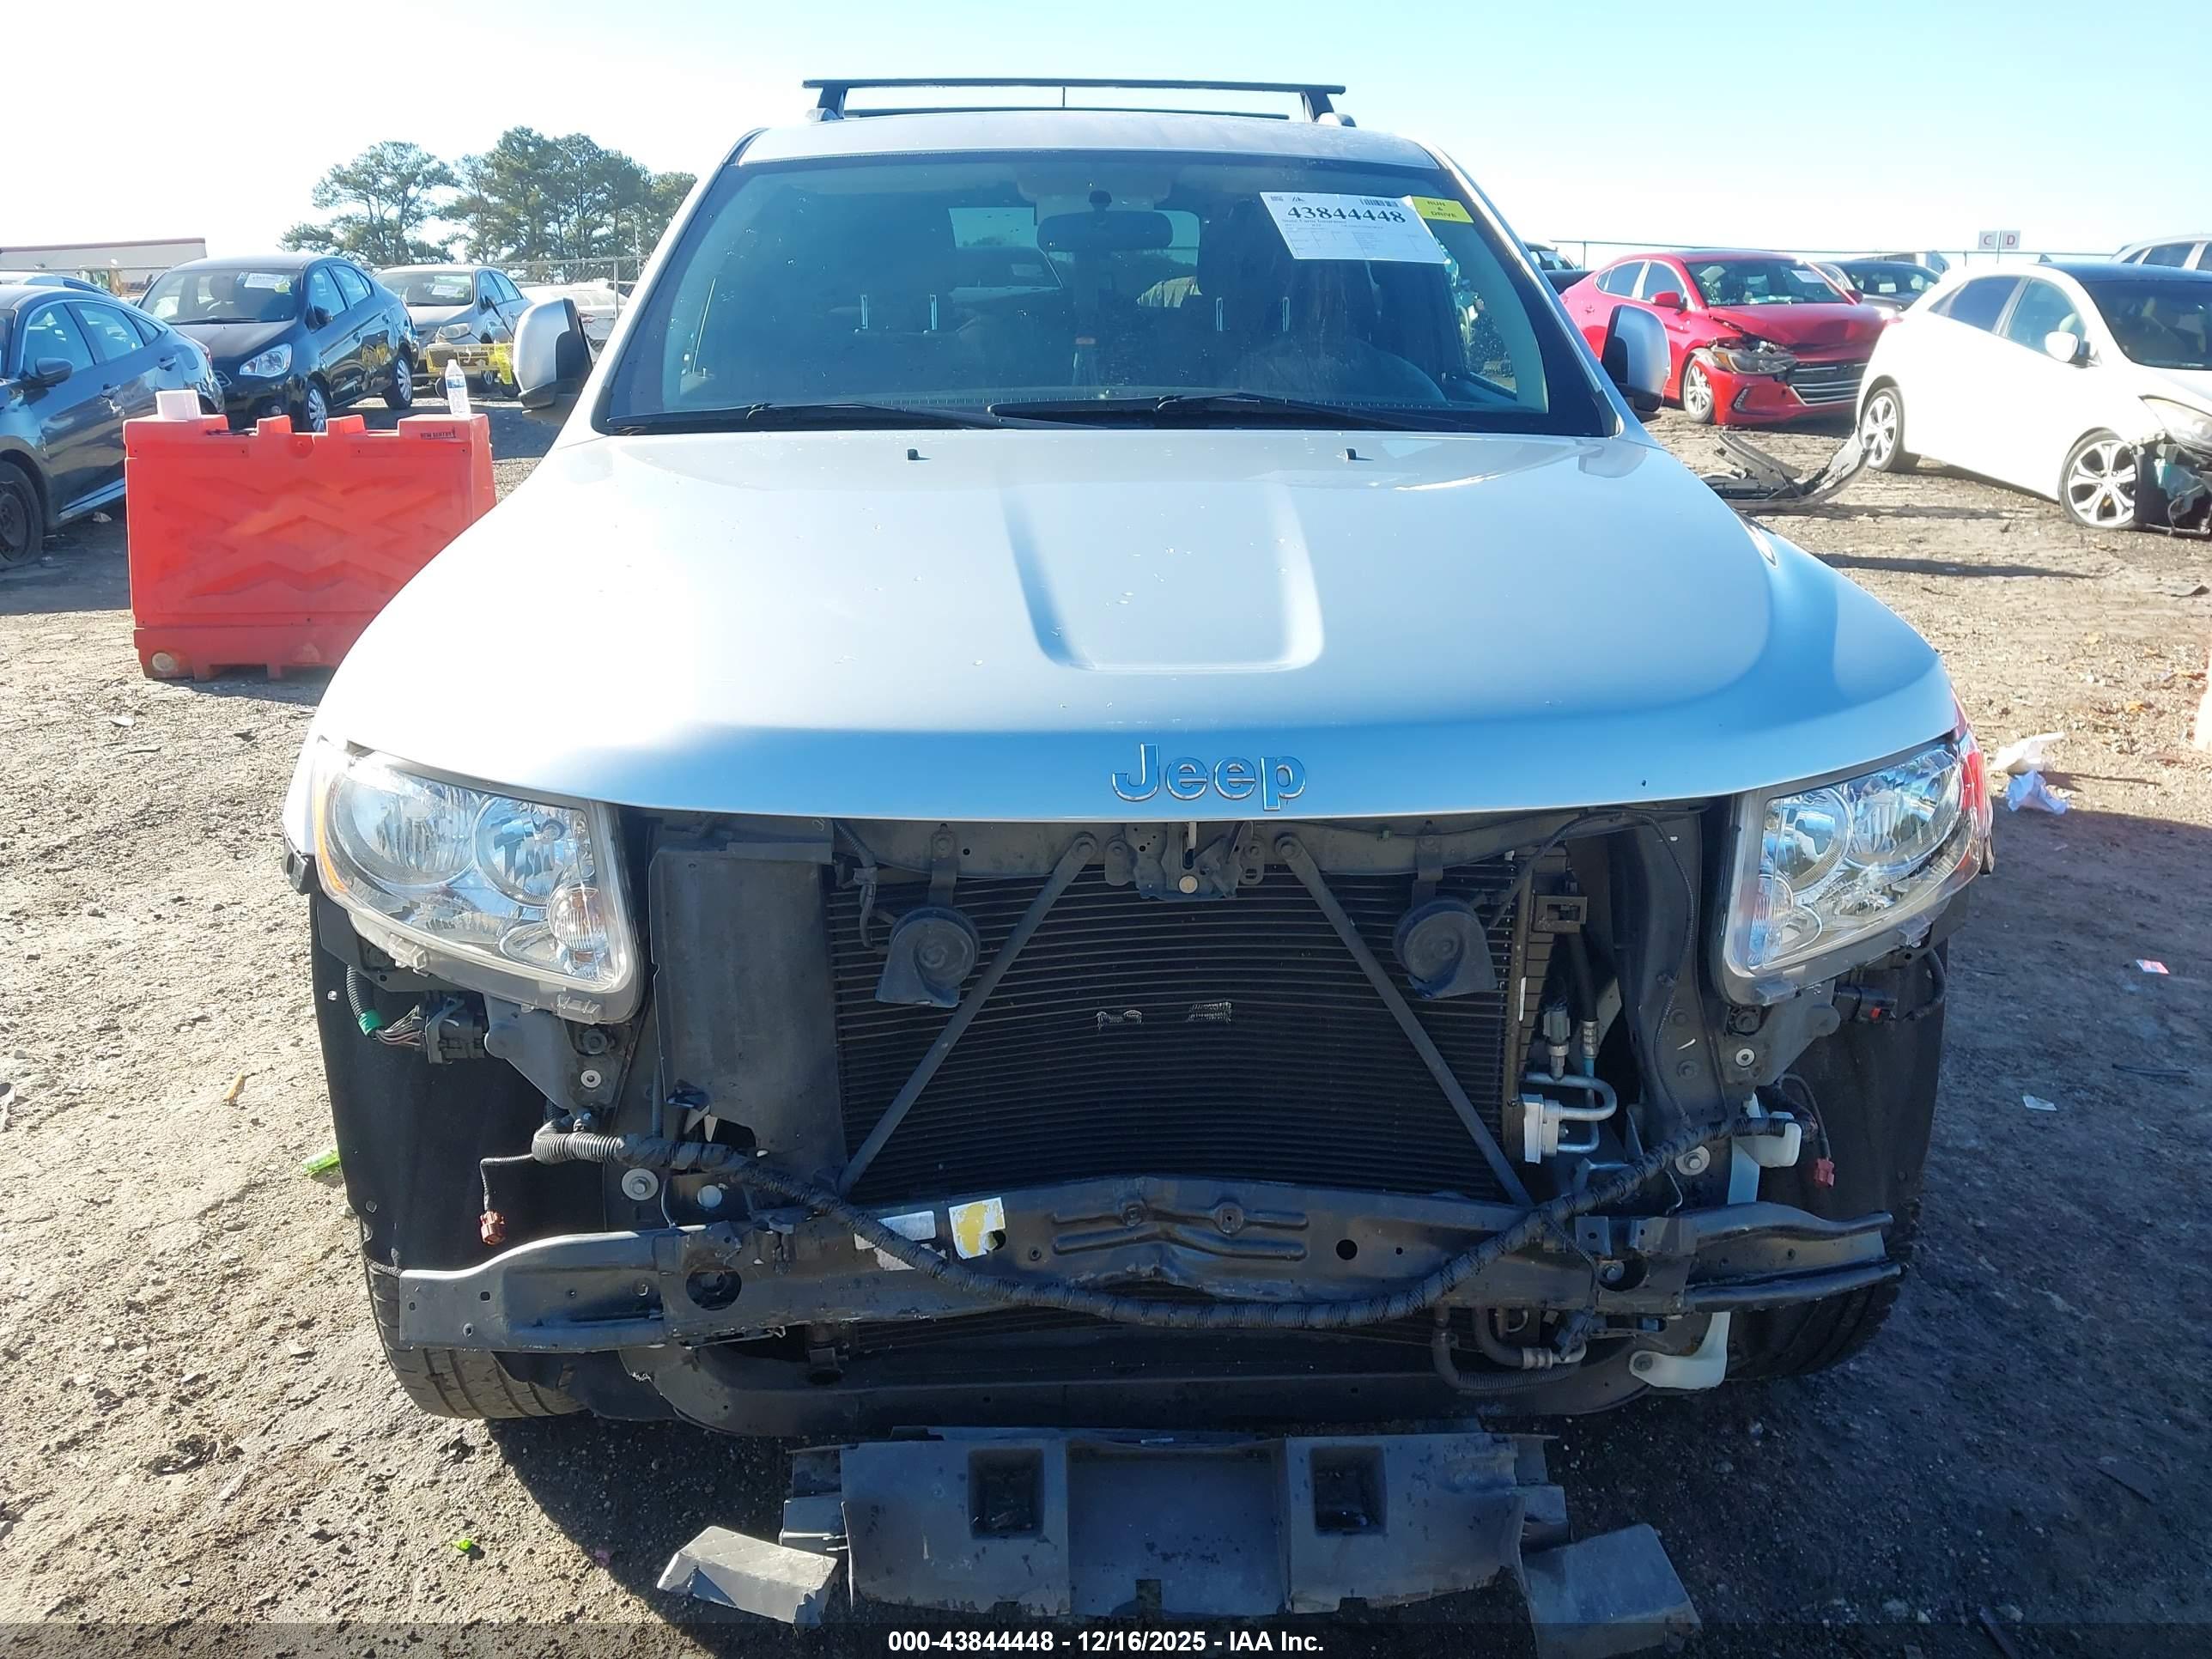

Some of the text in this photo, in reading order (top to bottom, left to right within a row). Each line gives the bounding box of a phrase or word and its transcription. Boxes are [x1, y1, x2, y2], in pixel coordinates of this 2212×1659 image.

[1287, 206, 1407, 223] 43844448
[1984, 234, 1993, 246] C
[2007, 234, 2016, 246] D
[1110, 742, 1306, 811] Jeep
